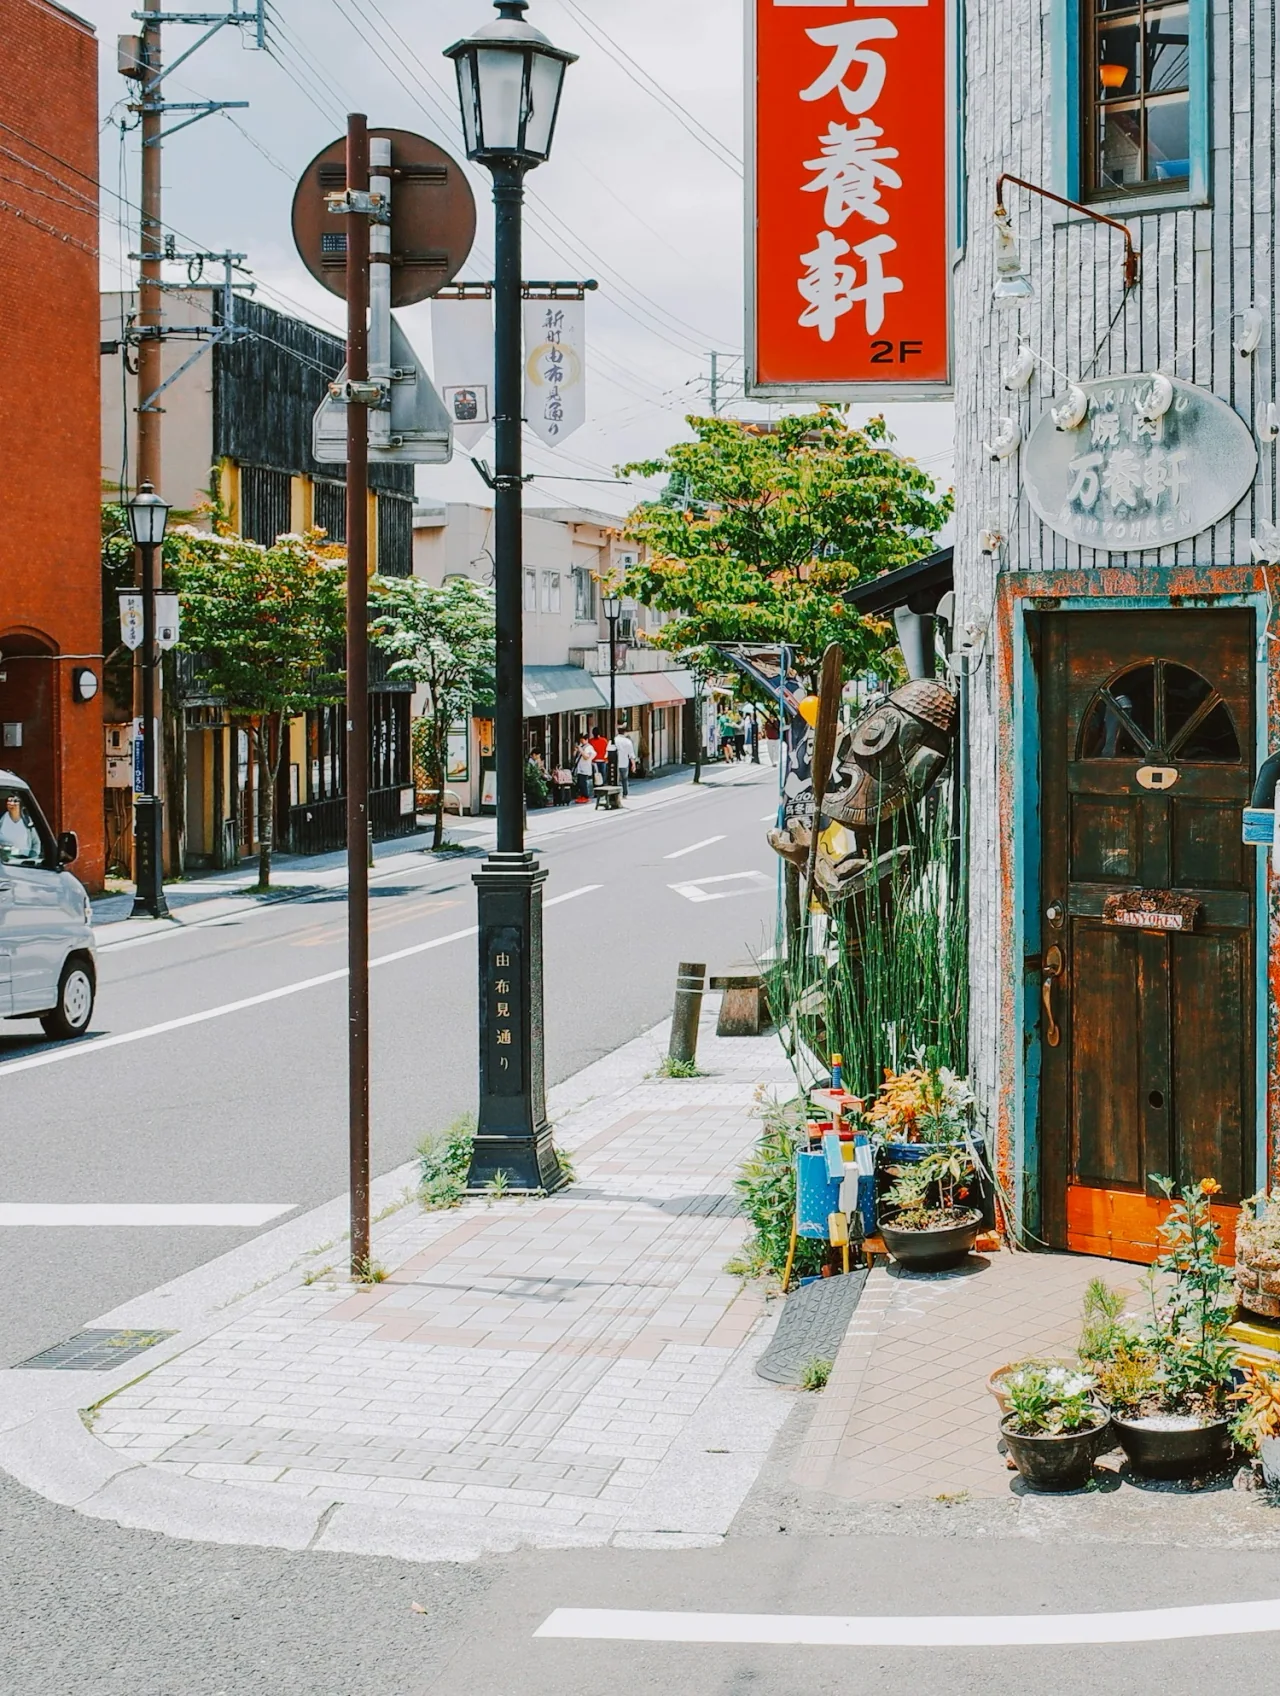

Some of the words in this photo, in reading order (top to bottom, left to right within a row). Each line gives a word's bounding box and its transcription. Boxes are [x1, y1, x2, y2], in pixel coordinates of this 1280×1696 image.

[797, 17, 904, 342] 万養軒
[541, 308, 565, 436] 新町由布見通り
[869, 340, 923, 363] 2F
[1067, 448, 1188, 506] 万養軒
[495, 952, 512, 1071] 由布見通り
